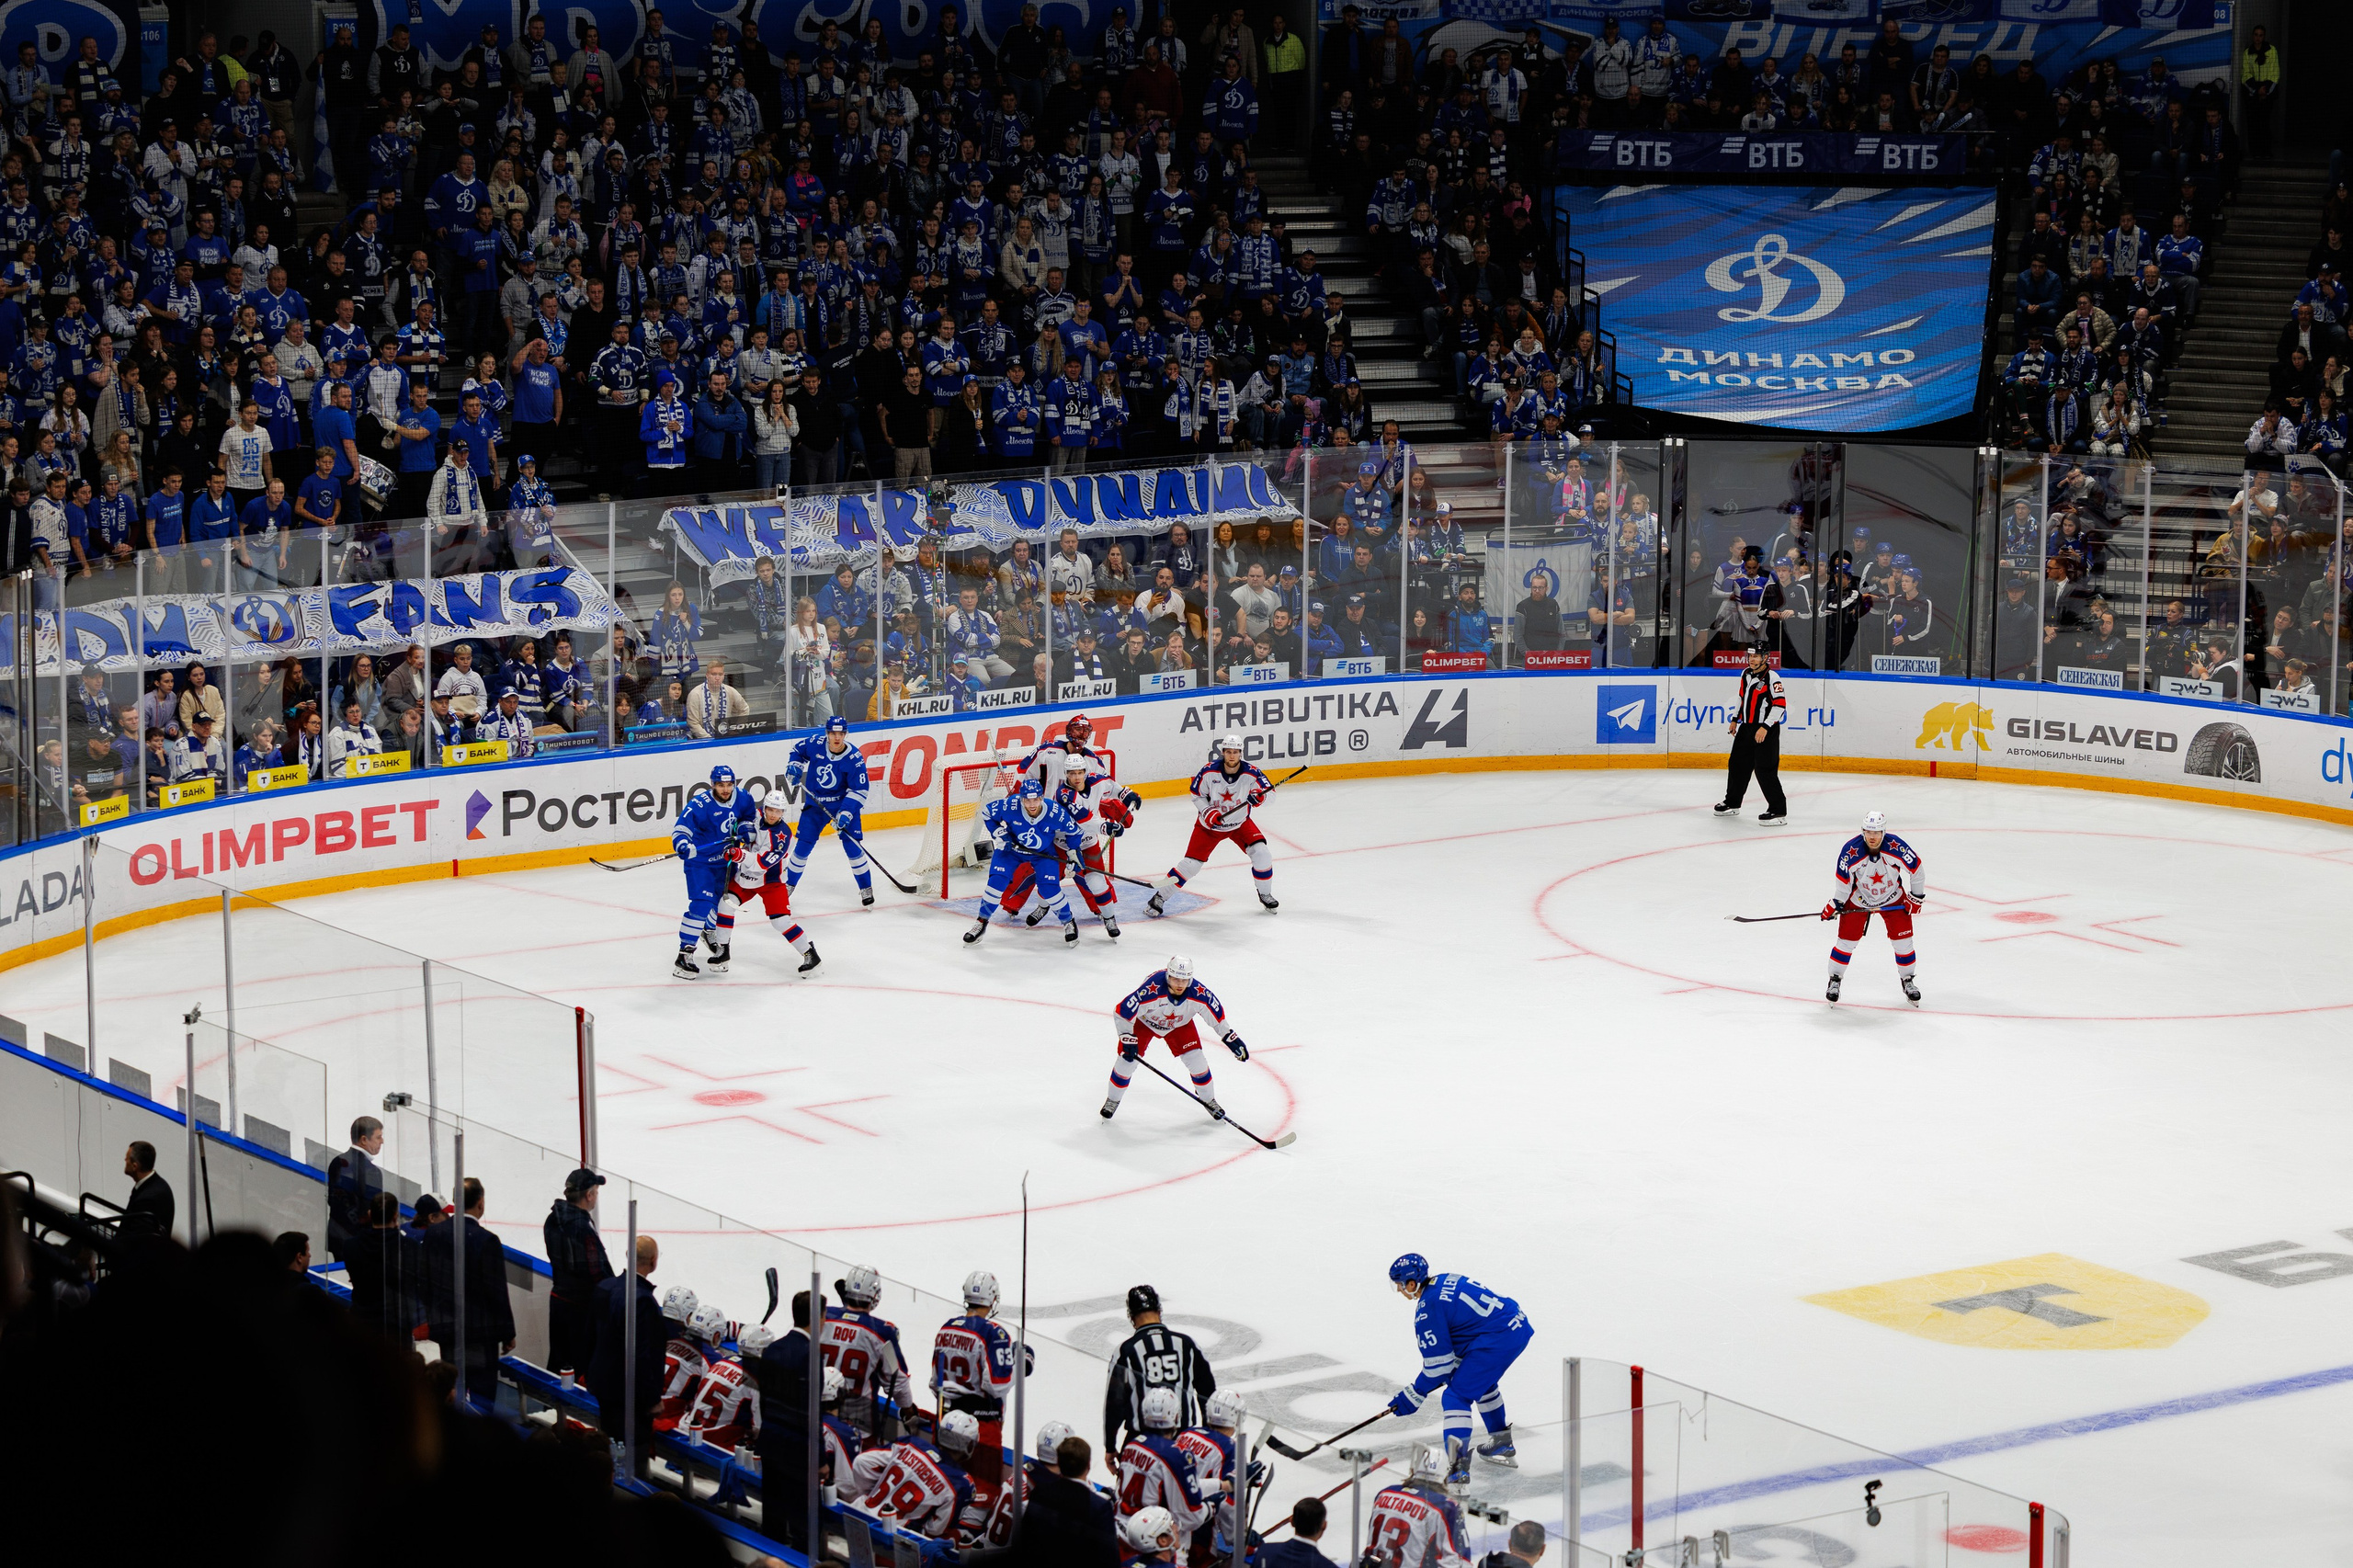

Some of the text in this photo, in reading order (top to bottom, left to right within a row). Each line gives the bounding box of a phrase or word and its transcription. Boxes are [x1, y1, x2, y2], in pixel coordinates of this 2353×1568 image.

[1559, 8, 1654, 18] ДИНАМО МОСКВА
[1616, 141, 1673, 167] ВТБ
[1748, 142, 1805, 168] ВТБ
[1883, 143, 1938, 170] ВТБ
[1657, 347, 1915, 369] ДИНАМО
[1665, 369, 1914, 391] МОСКВА
[673, 504, 806, 567] WE
[328, 564, 584, 641] FANS
[1347, 661, 1372, 675] ВТБ
[1424, 656, 1485, 667] OLIMPBET
[1527, 654, 1590, 666] OLIMPBET
[1874, 658, 1938, 674] СЕНЕЖСКАЯ
[1163, 675, 1186, 690] ВТБ
[1254, 667, 1277, 682] ВТБ
[2060, 669, 2120, 687] СЕНЕЖСКАЯ
[980, 689, 1032, 708] KHL.RU
[1061, 681, 1113, 699] KHL.RU
[897, 699, 950, 716] KHL.RU
[1179, 690, 1399, 733] ATRIBUTIKA
[635, 729, 684, 741] THUNDEROBOT
[729, 721, 767, 732] SOYUZ
[2006, 717, 2178, 753] GISLAVED
[545, 738, 595, 749] THUNDEROBOT
[469, 748, 497, 758] БАНК
[2006, 748, 2126, 766] АВТОМОБИЛЬНЫЕ ШИНЫ
[372, 758, 401, 769] БАНК
[272, 771, 299, 783] БАНК
[182, 785, 206, 799] БАНК
[99, 803, 121, 816] БАНК
[129, 799, 440, 886] OLIMPBET
[832, 1325, 858, 1344] ROY
[995, 1347, 1012, 1367] 63
[1145, 1354, 1180, 1382] 85
[1376, 1494, 1430, 1522] POLTAPOV
